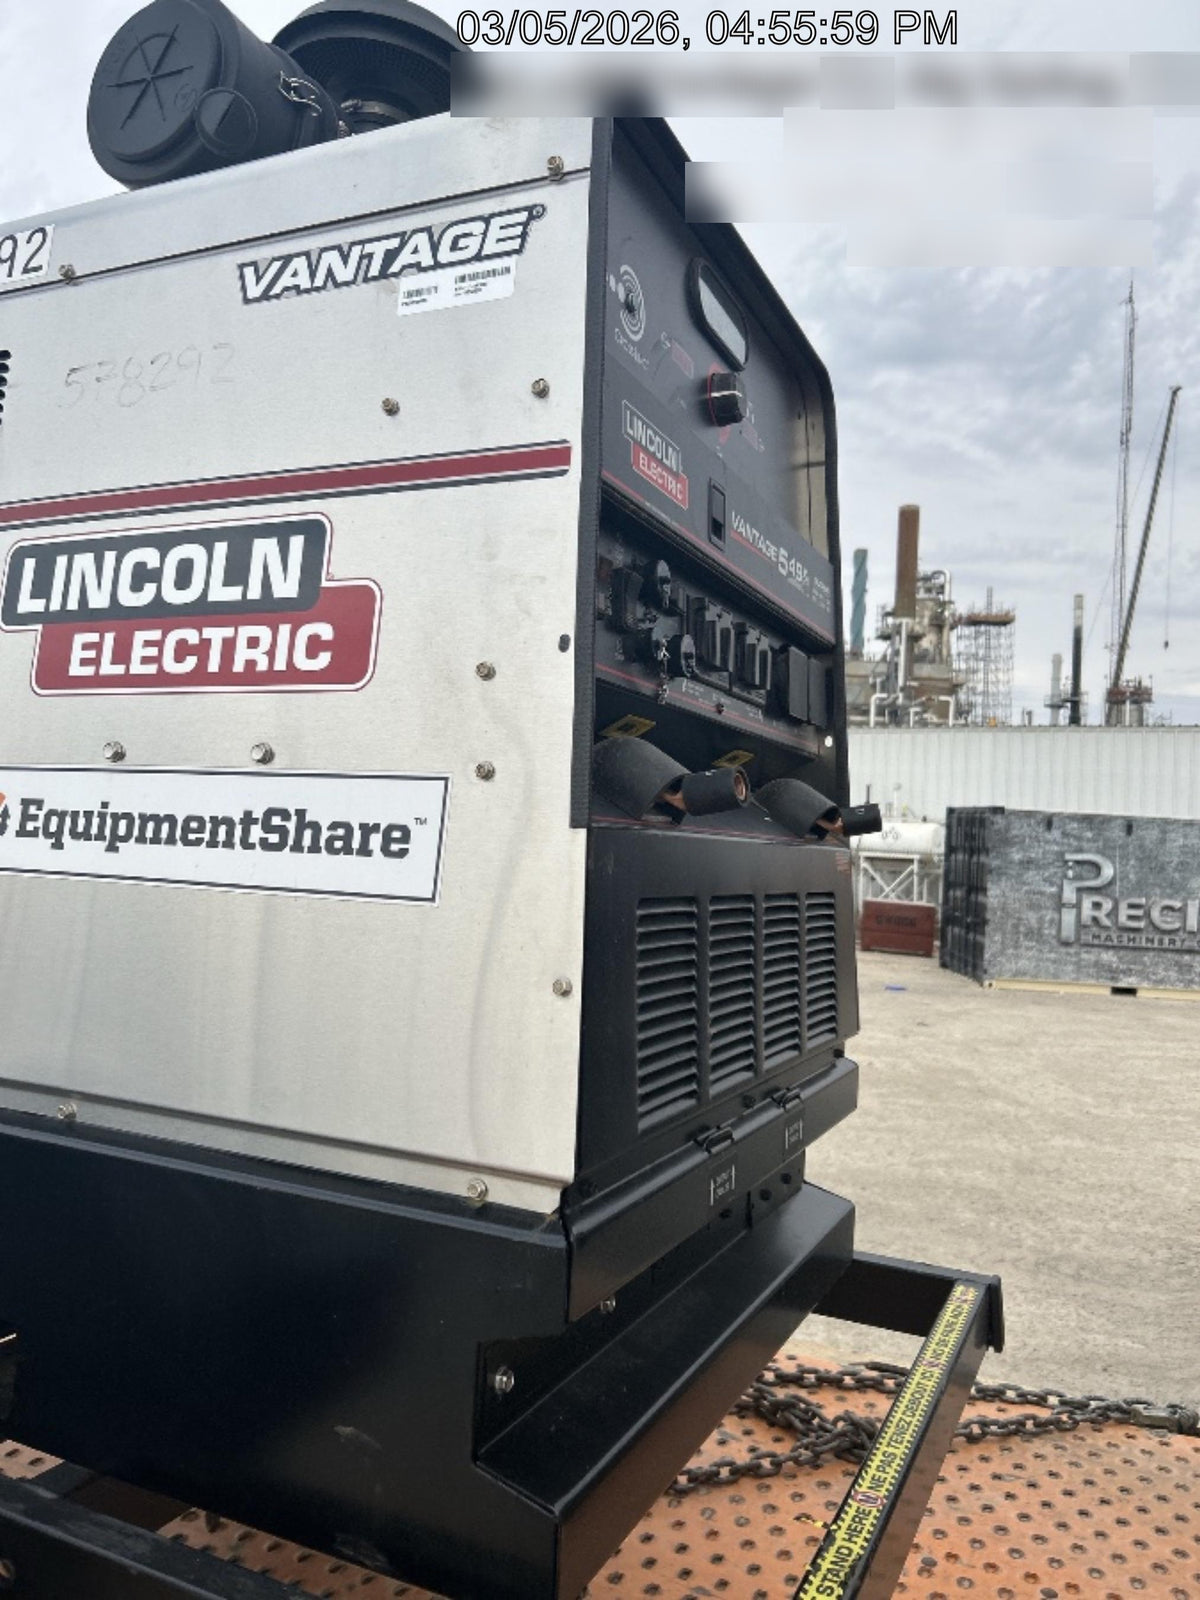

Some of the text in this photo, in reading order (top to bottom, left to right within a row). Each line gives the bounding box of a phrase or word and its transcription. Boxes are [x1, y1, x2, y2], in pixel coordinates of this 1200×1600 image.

[239, 207, 535, 303] VANTAGE
[627, 410, 678, 473] LINCOLN
[640, 451, 683, 500] ELECTRIC
[731, 509, 778, 562] VANTAGE
[17, 535, 306, 613] LINCOLN
[68, 622, 335, 676] ELECTRIC
[866, 1473, 885, 1492] NE
[876, 1449, 898, 1475] PAS
[888, 1418, 912, 1450] TENEZ
[903, 1383, 929, 1419] DEBOUT
[815, 1506, 872, 1597] STAND HERE
